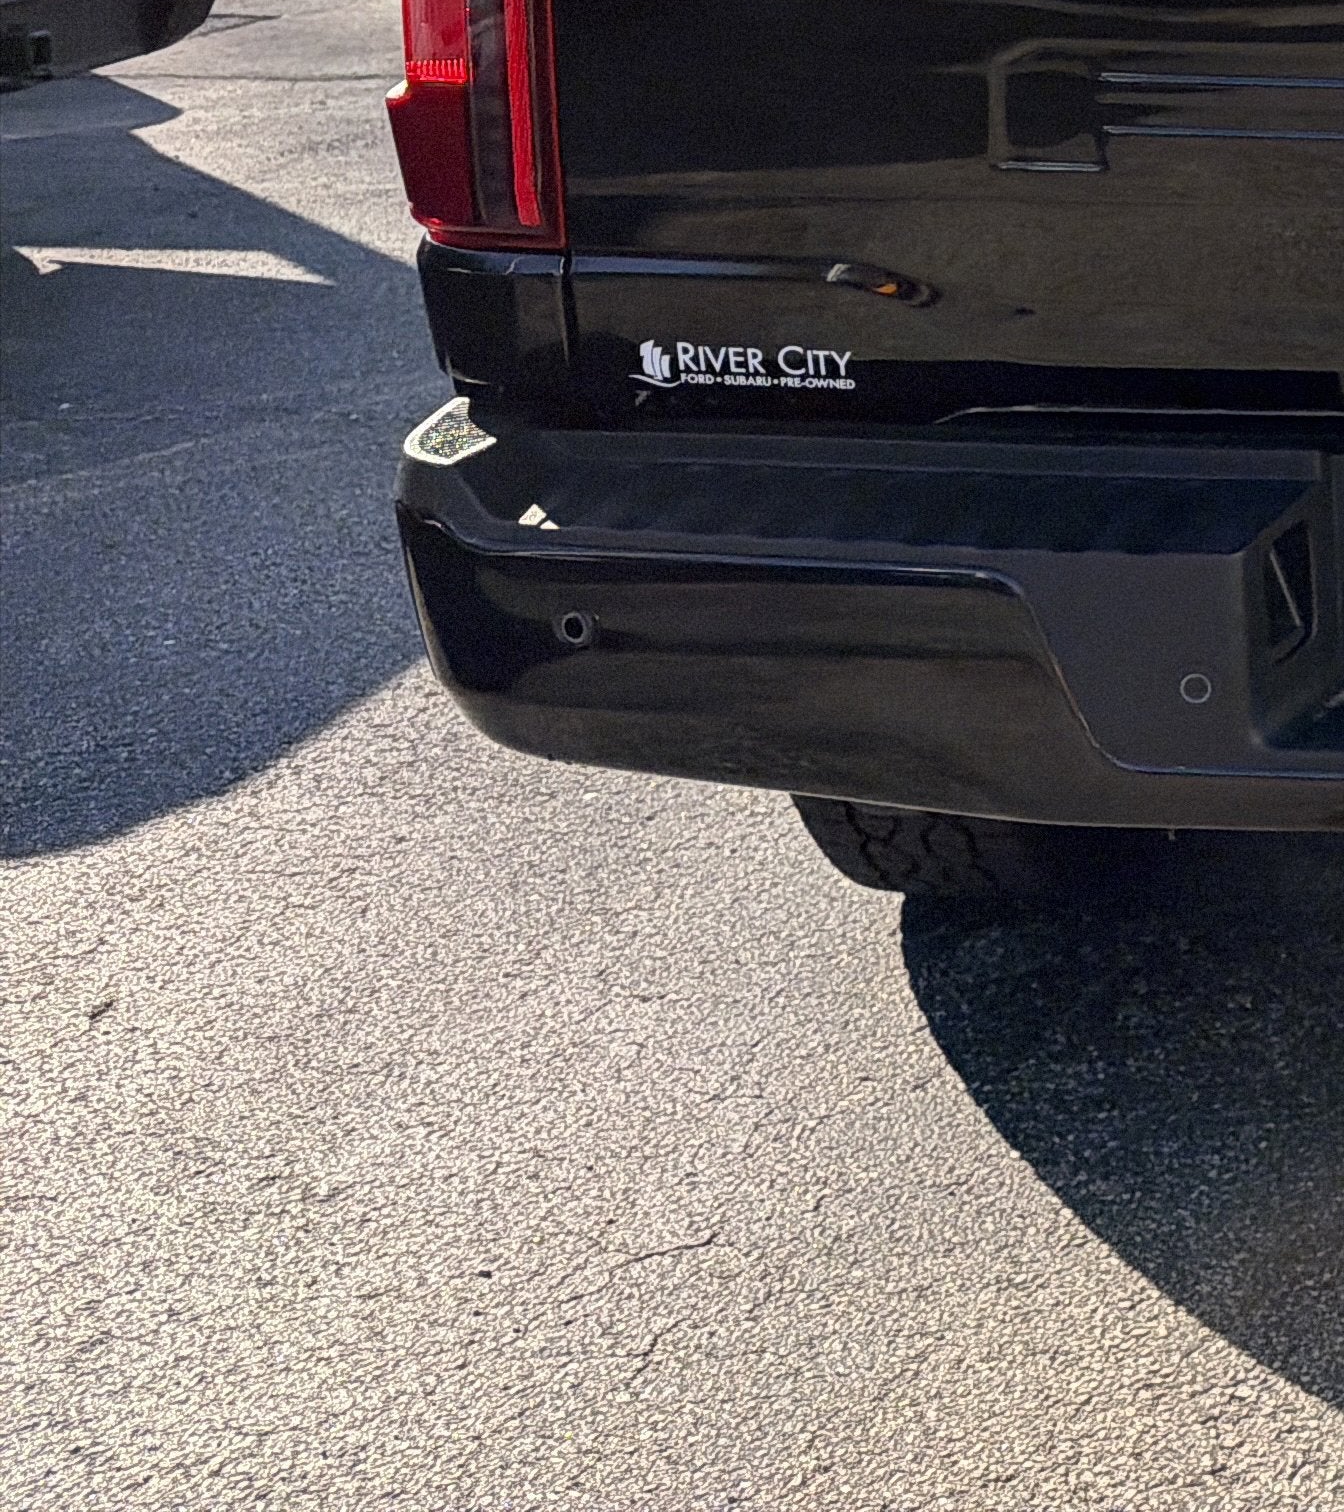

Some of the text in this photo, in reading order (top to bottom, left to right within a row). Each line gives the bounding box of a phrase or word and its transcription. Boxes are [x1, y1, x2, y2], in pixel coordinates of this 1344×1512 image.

[676, 341, 852, 377] RIVER CITY
[680, 372, 856, 390] FORD SUBARU PRE-OWNED
